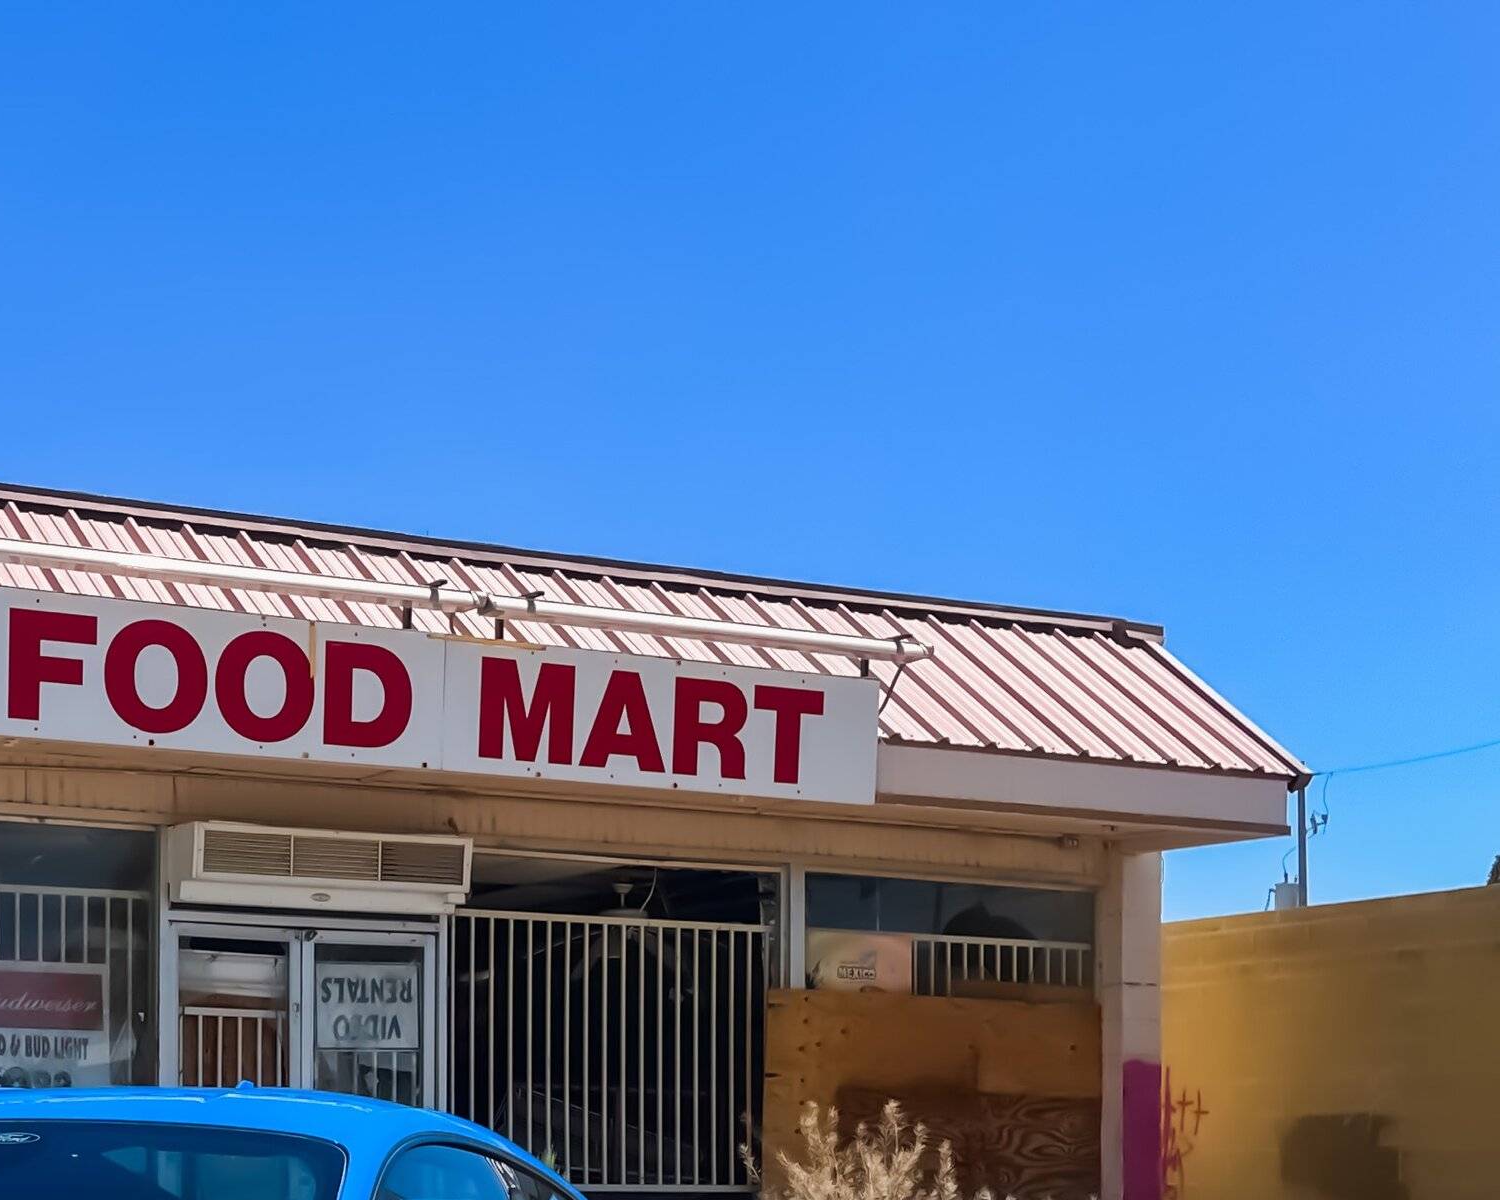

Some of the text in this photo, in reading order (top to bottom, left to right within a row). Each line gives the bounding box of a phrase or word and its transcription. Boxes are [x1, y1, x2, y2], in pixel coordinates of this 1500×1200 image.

[8, 608, 825, 785] FOOD MART
[321, 977, 412, 1004] RENTALS
[10, 1033, 21, 1058] &
[25, 1034, 50, 1058] BUD
[54, 1036, 89, 1060] LIGHT
